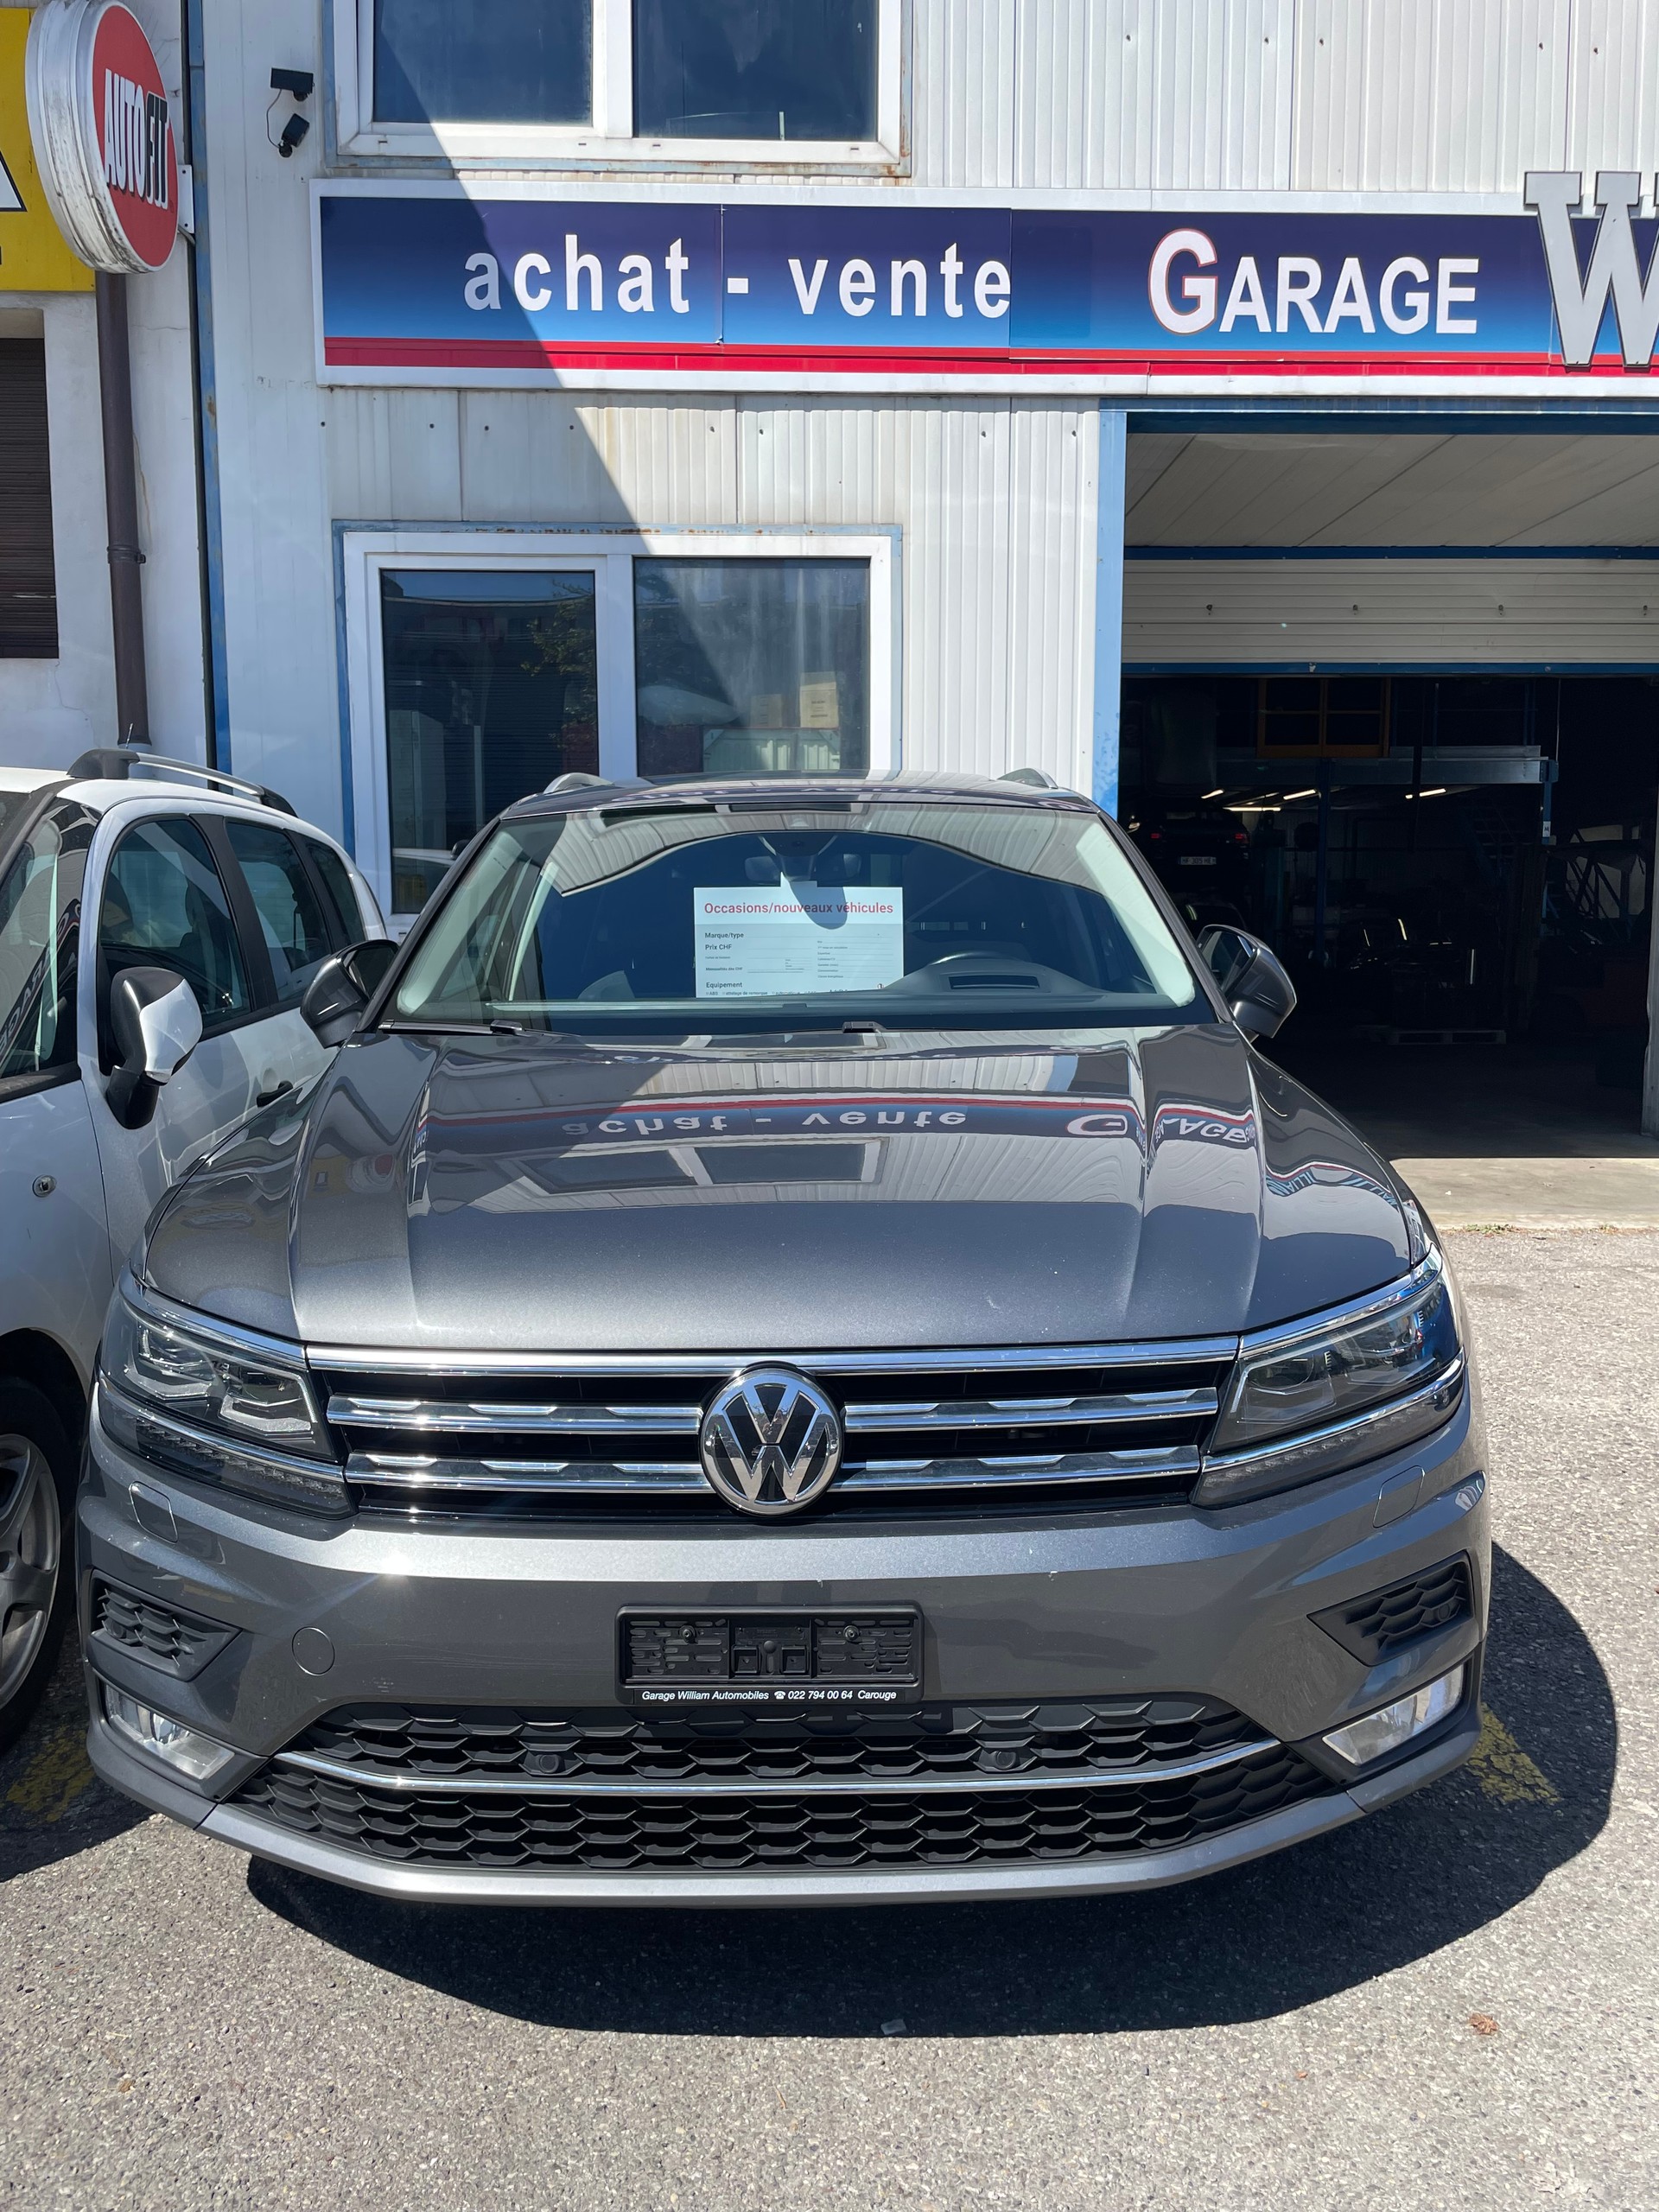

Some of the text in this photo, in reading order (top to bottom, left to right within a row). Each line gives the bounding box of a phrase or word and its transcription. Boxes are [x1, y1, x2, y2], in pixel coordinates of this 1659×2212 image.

[464, 234, 690, 314] achat
[788, 243, 1012, 318] vente
[1148, 228, 1479, 335] GARAGE
[704, 901, 893, 914] Occasions/nouveaux véhicules
[641, 1689, 897, 1702] Garage William Automobiles 022 794 00 64 Carouge
